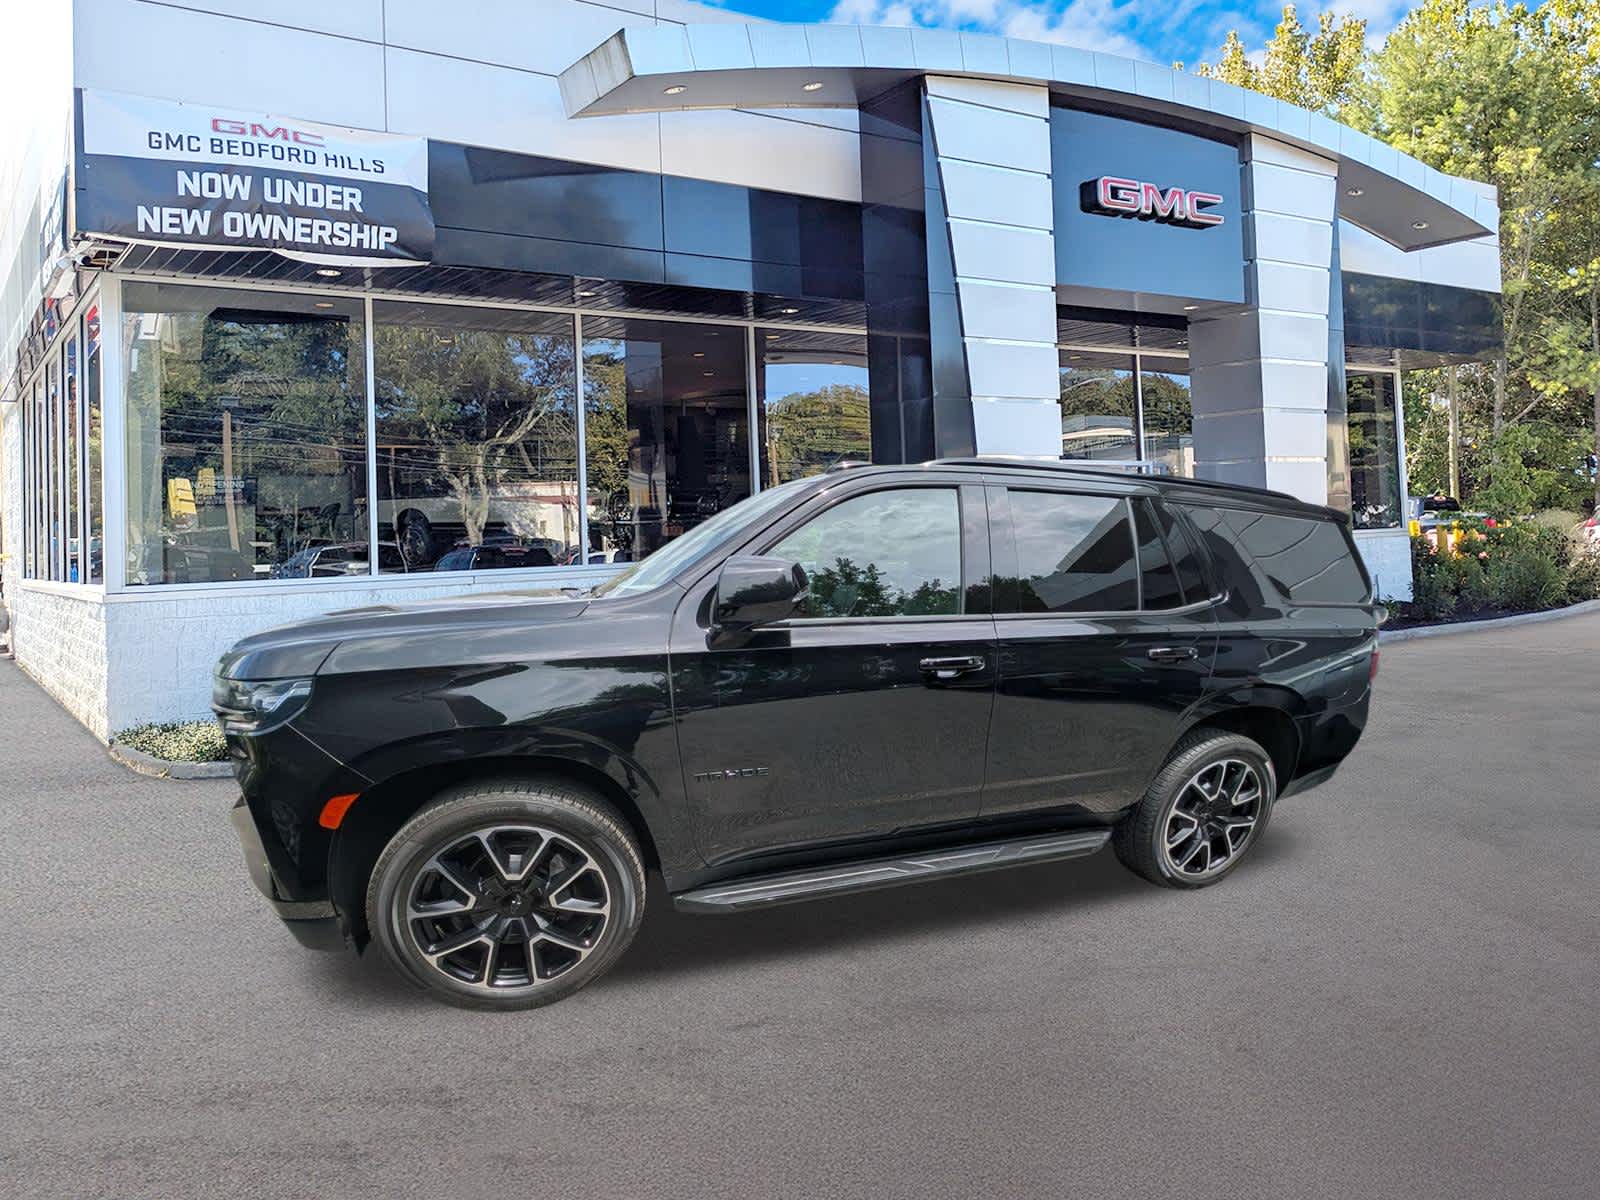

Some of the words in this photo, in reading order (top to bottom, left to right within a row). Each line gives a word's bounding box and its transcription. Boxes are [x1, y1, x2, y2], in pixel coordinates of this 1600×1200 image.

[148, 131, 201, 152] GMC
[210, 138, 317, 165] BEDFORD
[325, 153, 385, 174] HILLS
[211, 118, 326, 148] GMC
[177, 170, 252, 201] NOW
[263, 176, 364, 213] UNDER
[1097, 175, 1225, 225] GMC
[136, 205, 211, 235] NEW
[223, 211, 398, 250] OWNERSHIP
